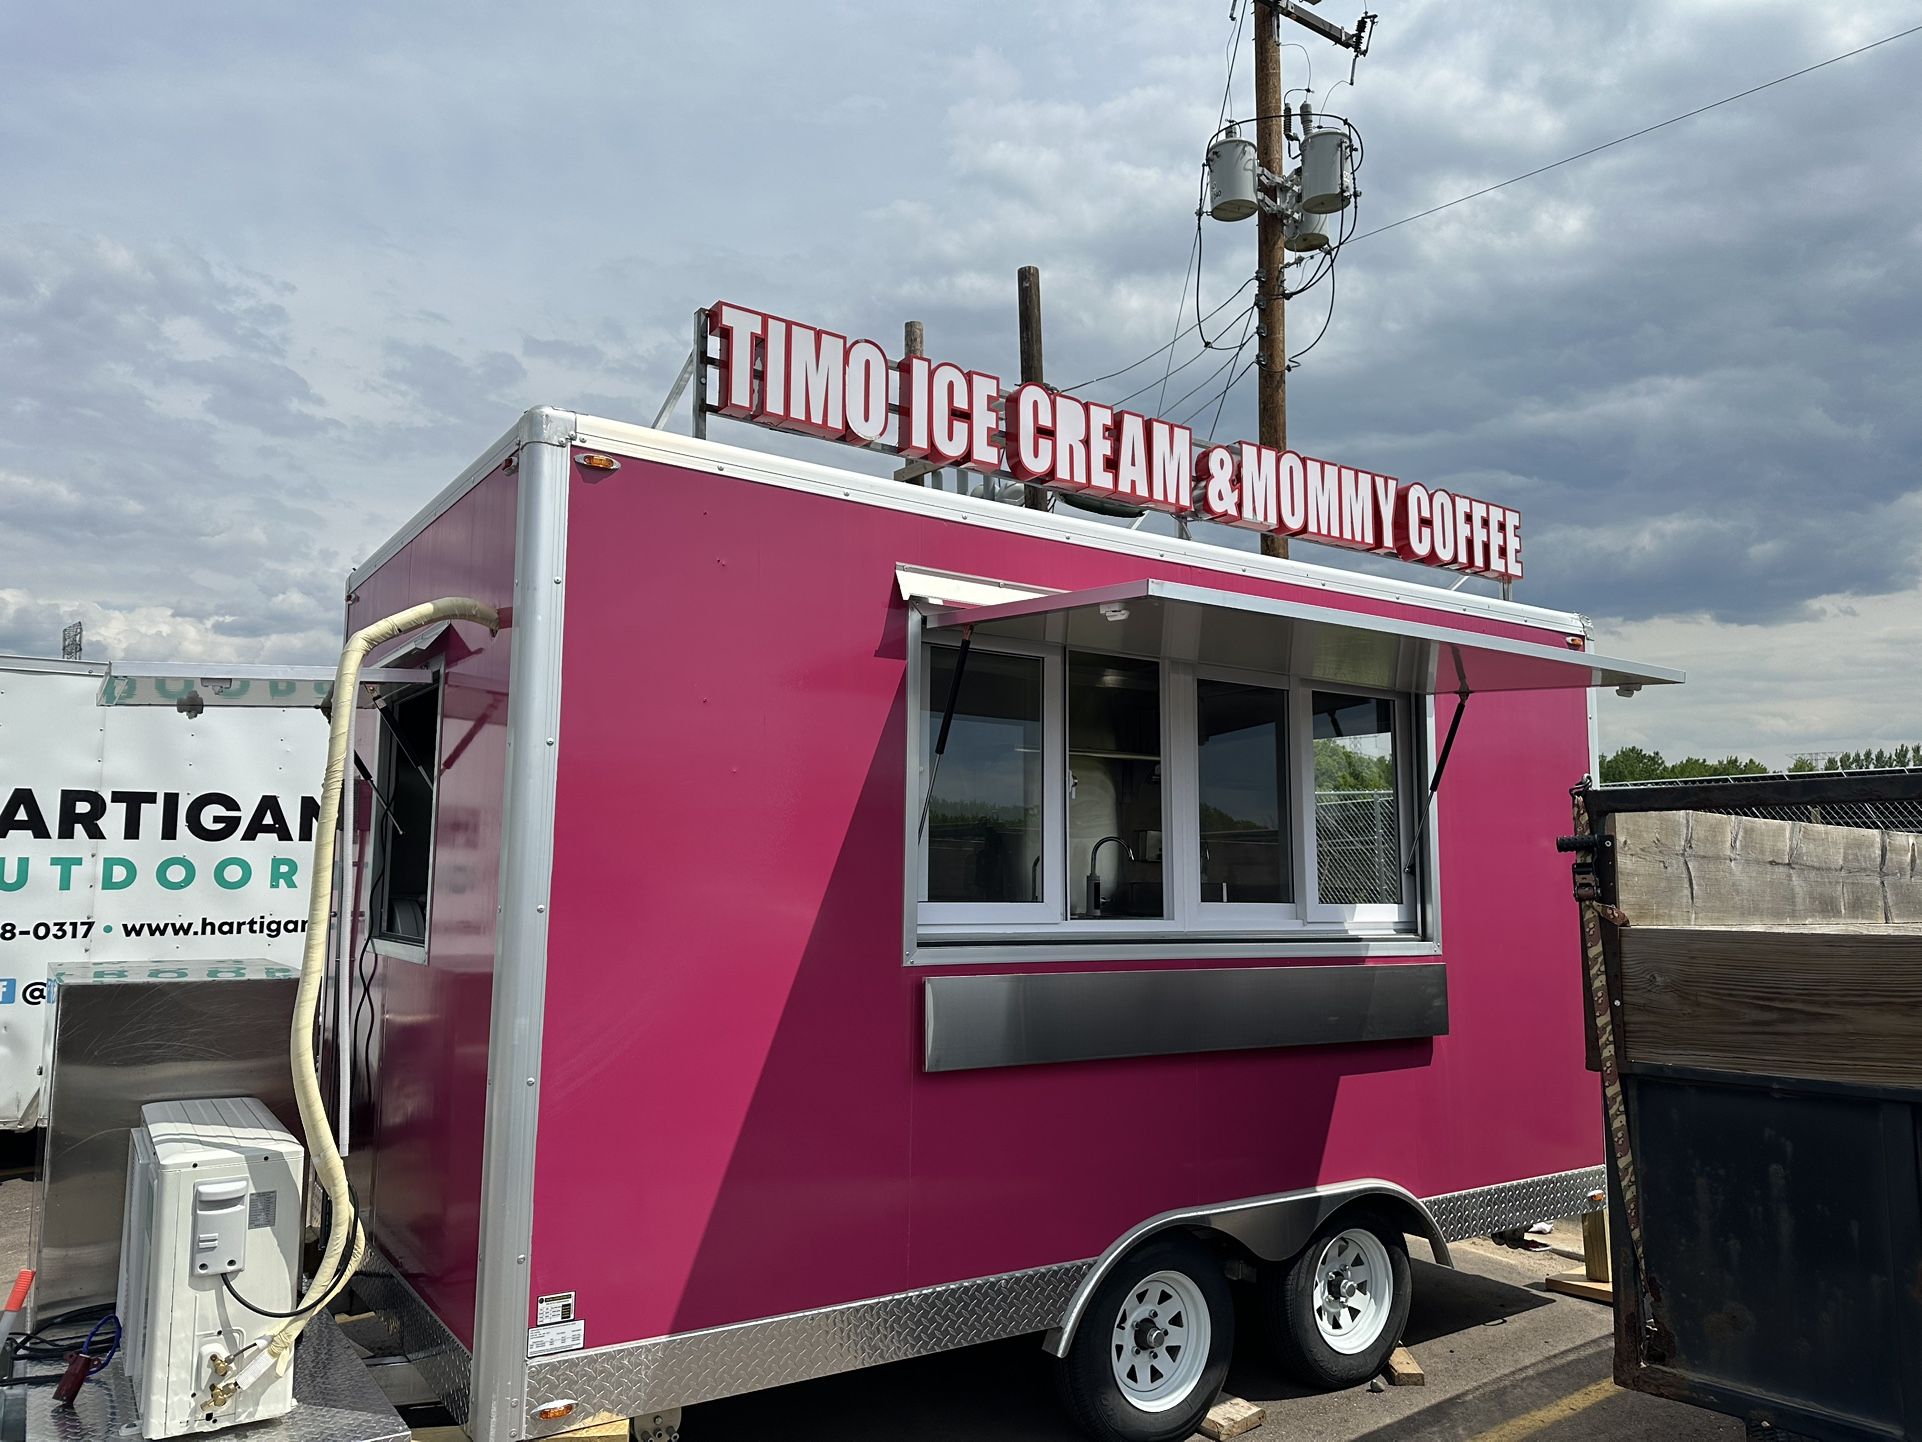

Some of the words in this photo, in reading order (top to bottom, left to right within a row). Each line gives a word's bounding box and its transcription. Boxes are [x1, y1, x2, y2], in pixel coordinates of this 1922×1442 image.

[714, 301, 889, 443] TIMO
[907, 356, 1000, 470] ICE
[1013, 382, 1193, 511] CREAM
[1204, 445, 1242, 518] &
[1240, 440, 1399, 550] MOMMY
[1404, 481, 1524, 579] COFFEE
[0, 920, 96, 941] 8-0317
